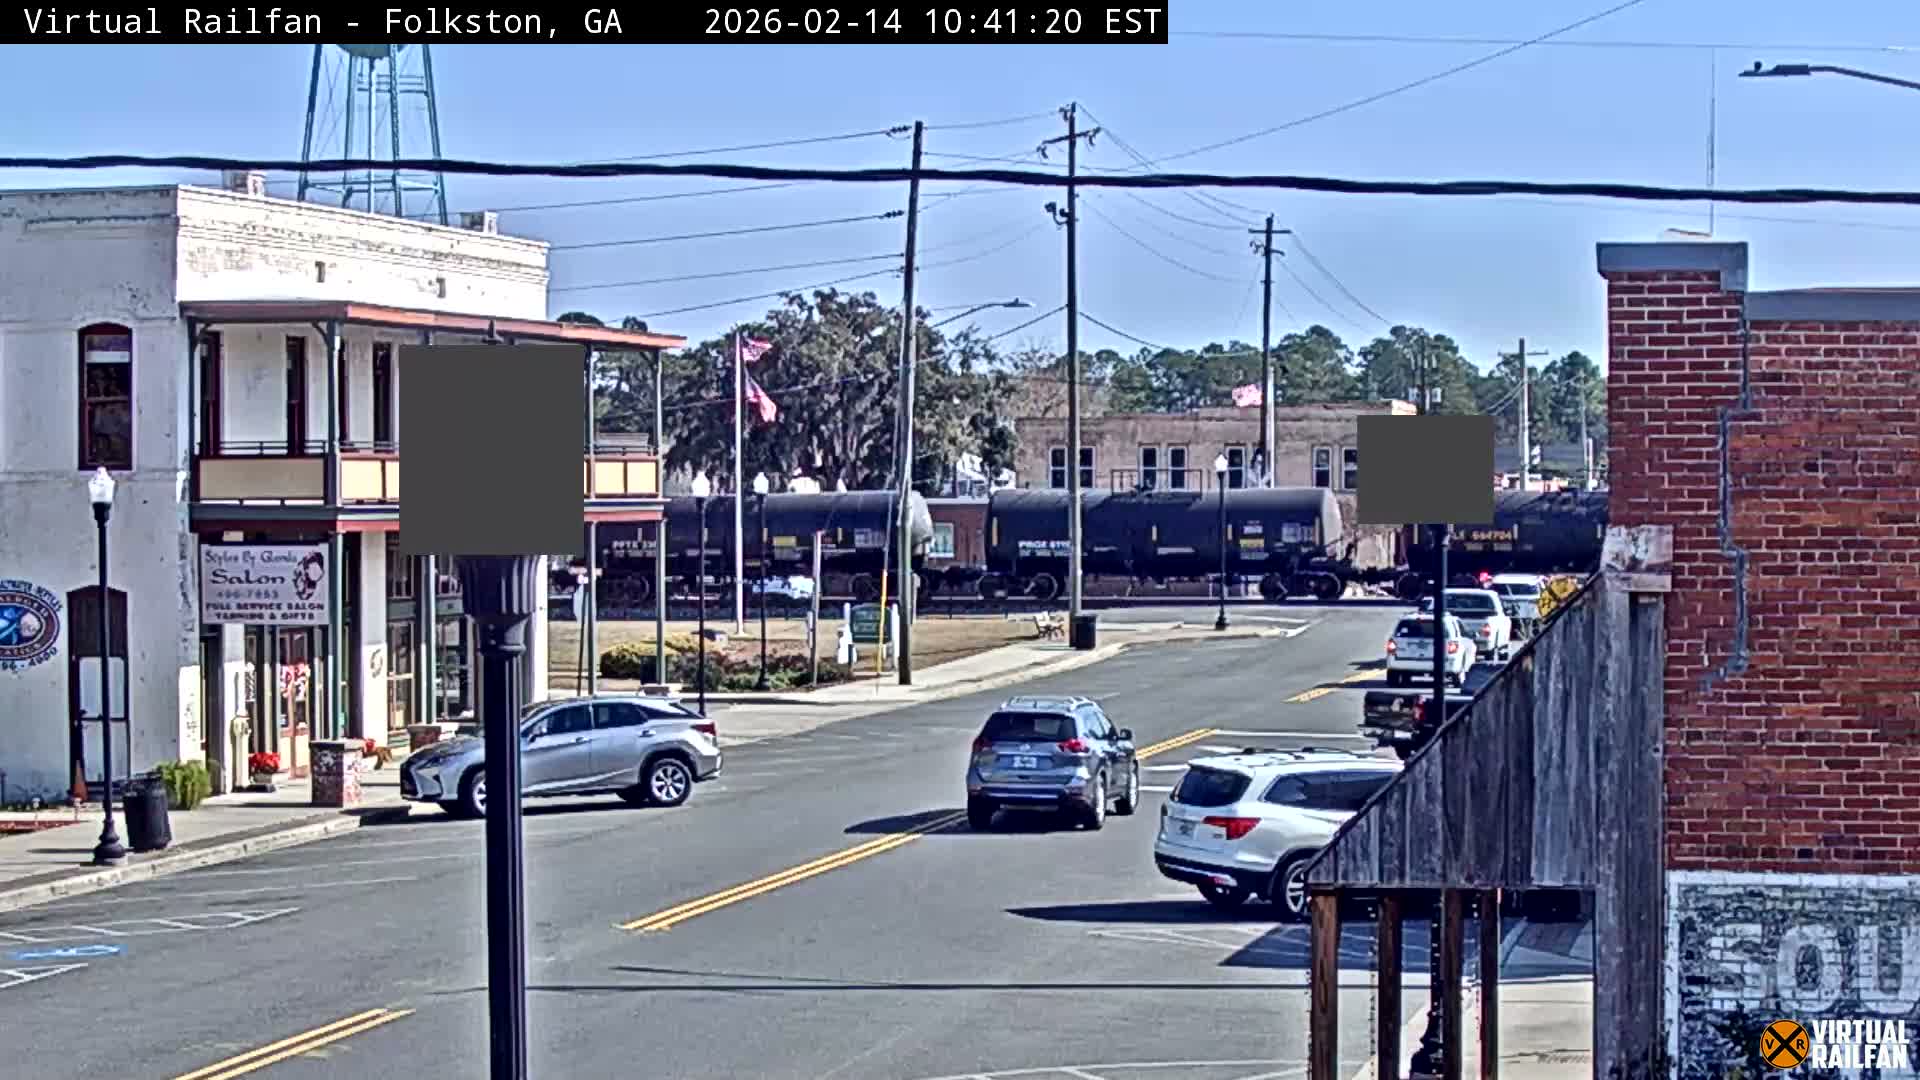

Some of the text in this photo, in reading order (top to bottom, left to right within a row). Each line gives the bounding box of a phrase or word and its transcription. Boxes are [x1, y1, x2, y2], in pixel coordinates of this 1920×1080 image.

[210, 568, 286, 585] Salon
[206, 602, 325, 611] FULL SERVICE SALON
